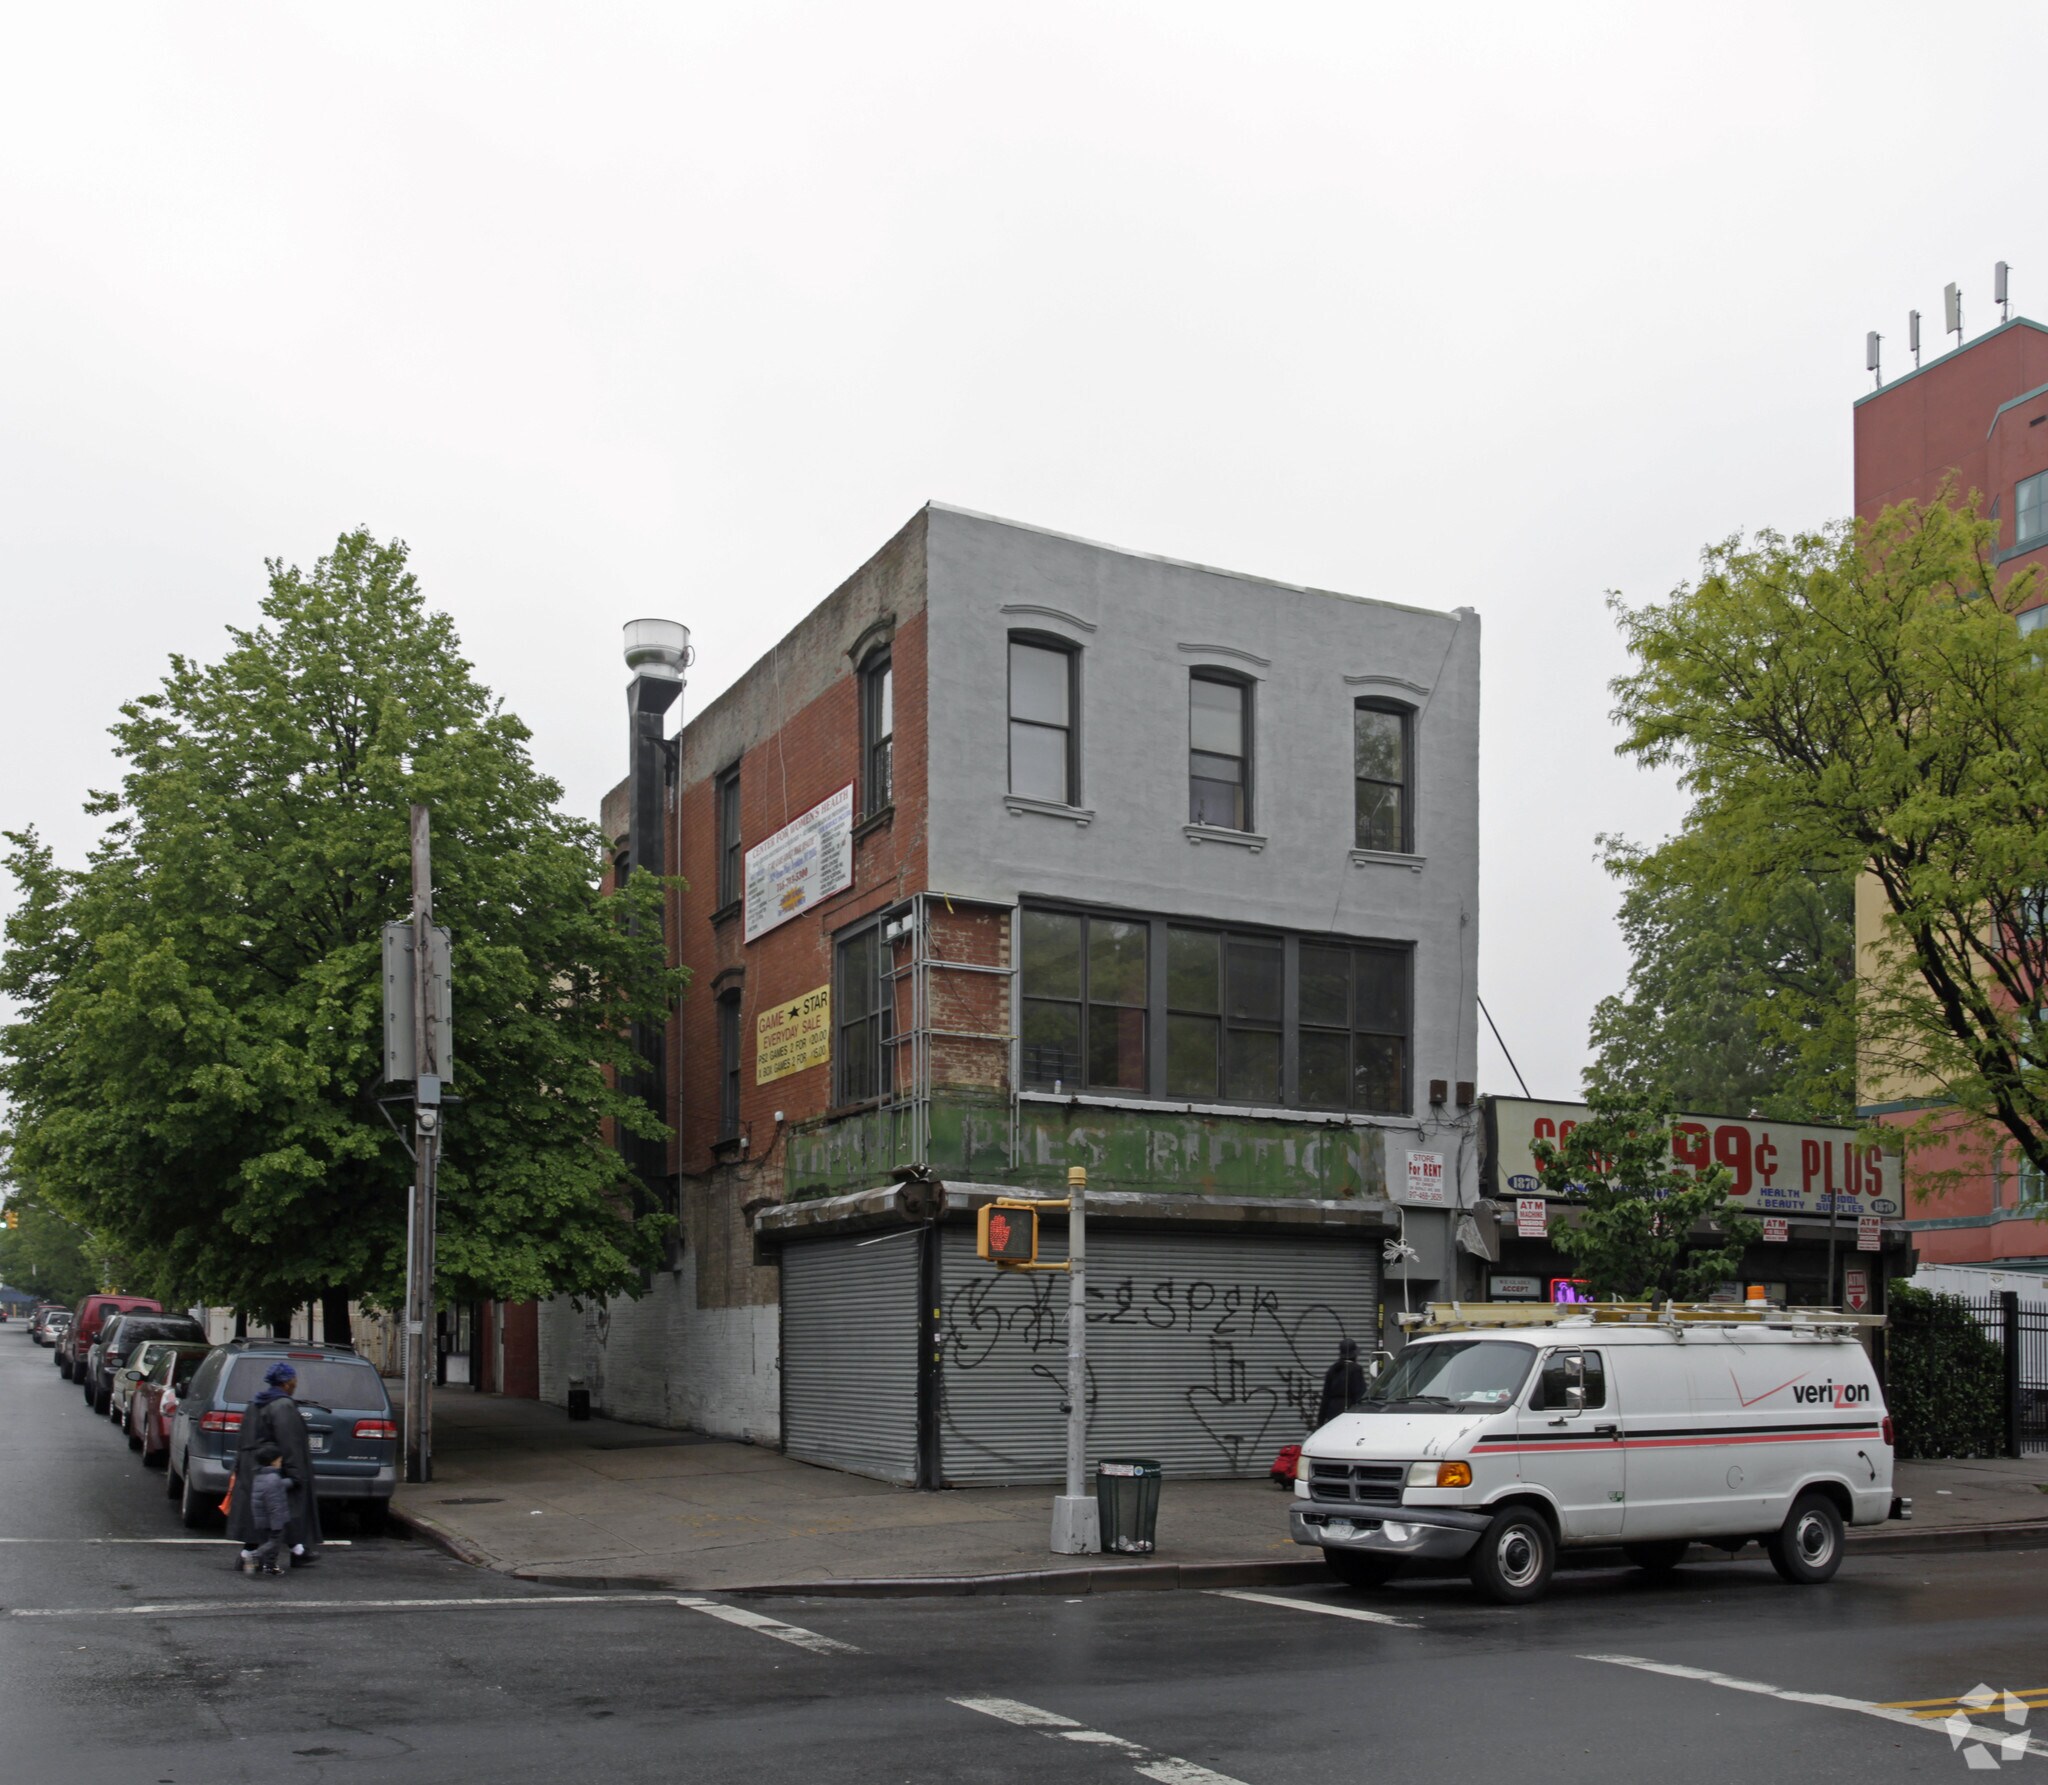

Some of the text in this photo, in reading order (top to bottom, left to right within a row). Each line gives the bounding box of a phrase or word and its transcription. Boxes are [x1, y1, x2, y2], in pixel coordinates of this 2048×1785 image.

[752, 836, 776, 859] CENTER
[776, 829, 789, 844] FOR
[789, 807, 820, 835] WOMEN'S
[820, 789, 849, 814] HEALTH
[758, 991, 828, 1034] GAME STAR
[763, 1014, 821, 1049] EVERYDAY SALE
[770, 1045, 788, 1060] GAMES
[795, 1038, 807, 1050] FOR
[774, 1058, 791, 1073] GAMES
[796, 1052, 807, 1064] FOR
[1412, 1153, 1435, 1163] STORE
[1408, 1161, 1442, 1178] For RENT
[1801, 1139, 1883, 1197] PLUS
[1512, 1176, 1538, 1190] 1870
[1760, 1188, 1800, 1198] HEALTH
[1520, 1200, 1543, 1210] ATM
[1764, 1198, 1805, 1209] BEAUTY
[1519, 1210, 1544, 1219] MACHINE
[1765, 1219, 1786, 1228] ATM
[1860, 1218, 1879, 1227] ATM
[1502, 1285, 1529, 1293] ACCEPT
[1793, 1378, 1870, 1409] verizon
